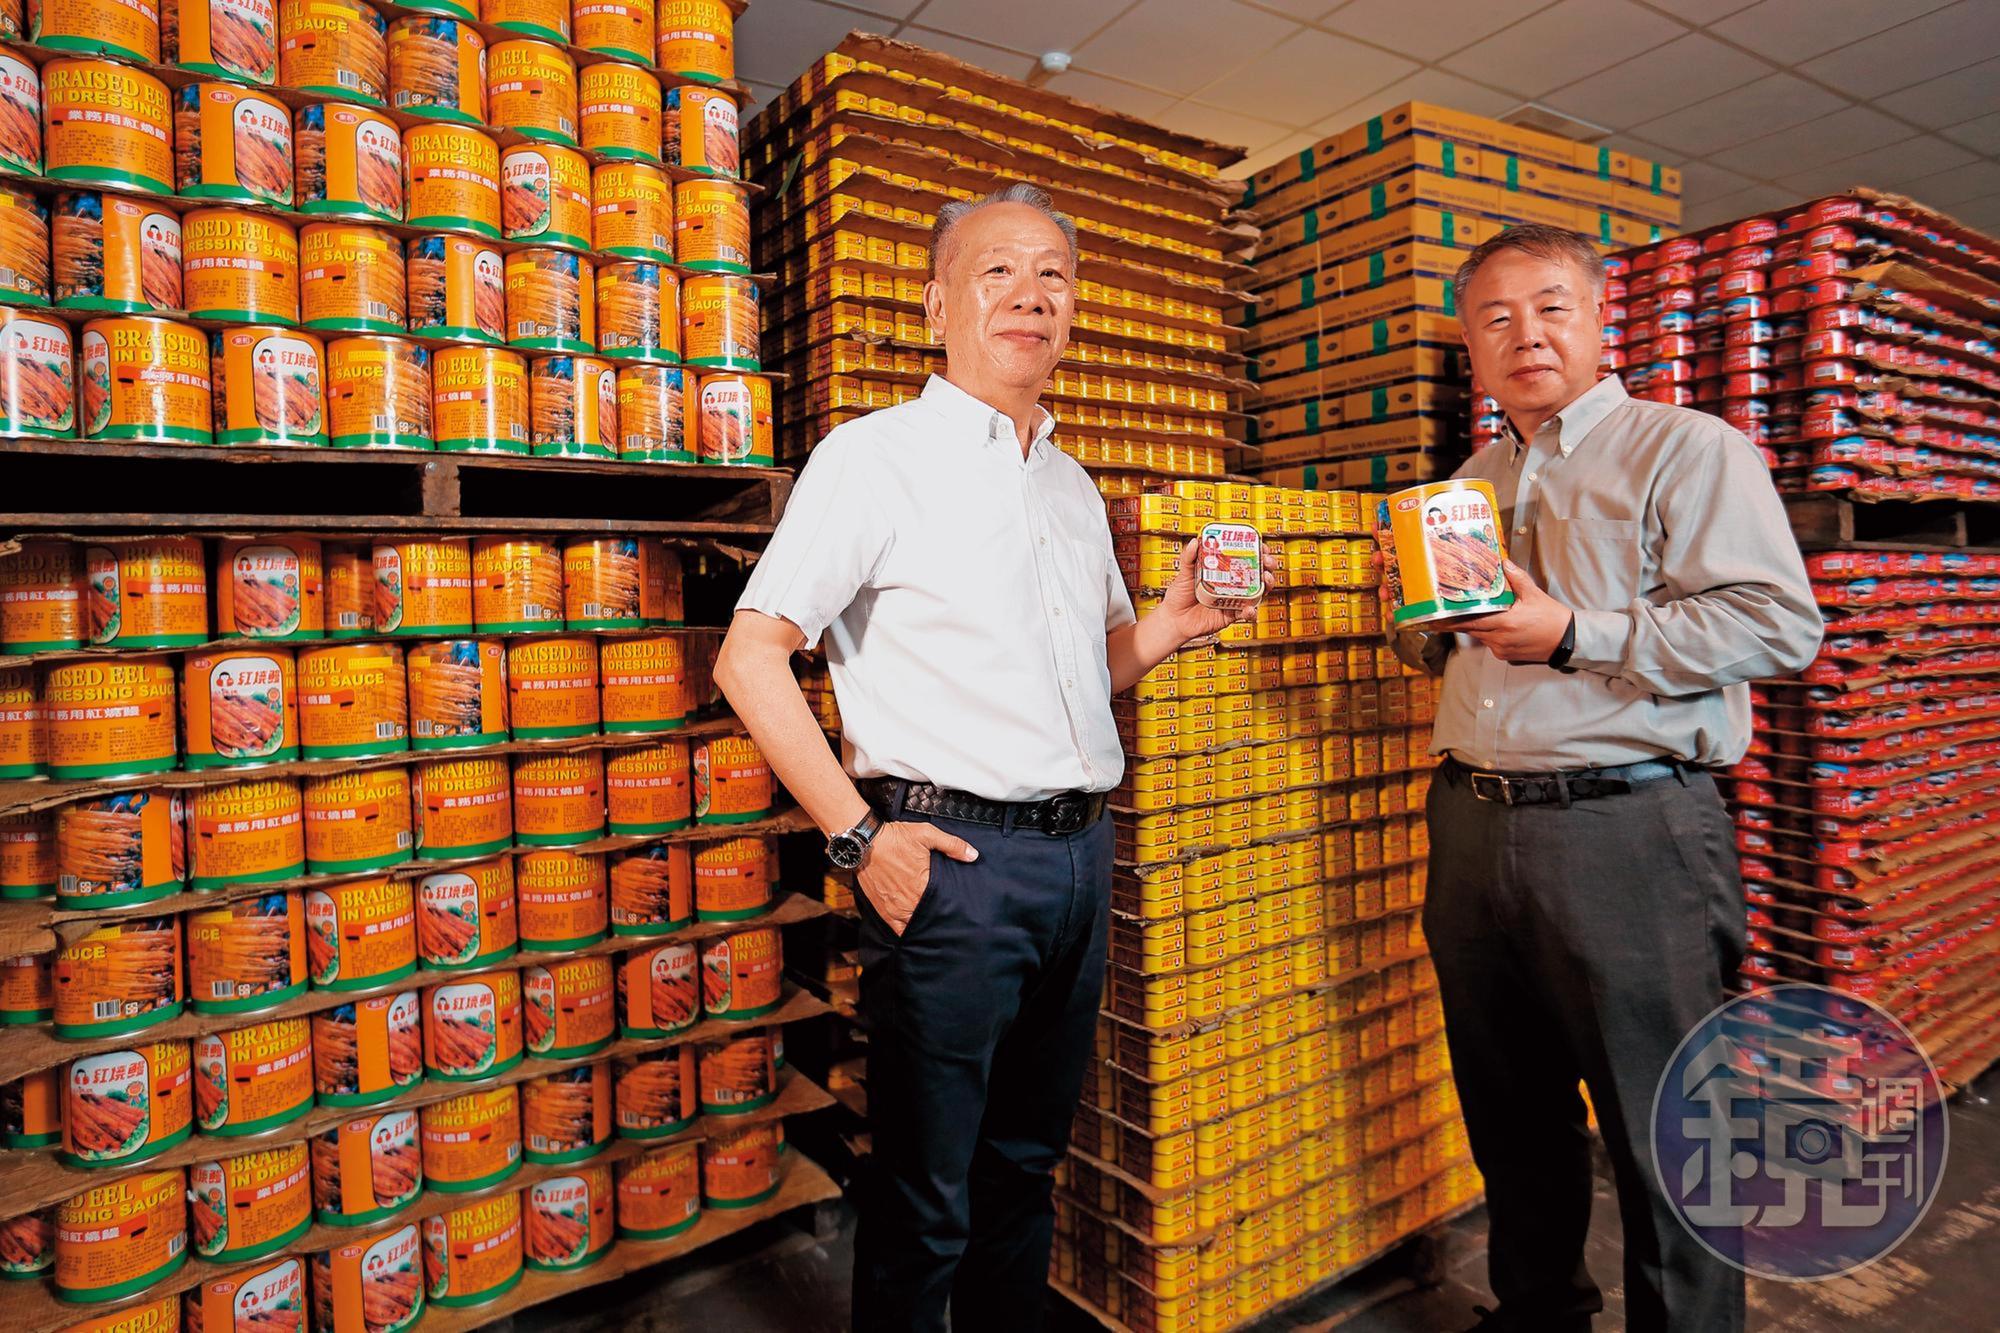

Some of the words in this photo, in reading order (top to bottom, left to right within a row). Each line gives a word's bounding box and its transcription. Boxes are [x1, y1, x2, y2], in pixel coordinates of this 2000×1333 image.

[695, 2, 721, 20] EEL
[294, 19, 348, 33] SAUCE
[502, 48, 532, 66] EEL
[522, 65, 567, 86] SAUCE
[613, 73, 643, 93] EEL
[49, 70, 140, 98] BRAISED
[68, 91, 162, 120] DRESSING
[67, 109, 166, 141] 業務用紅燒鰻
[412, 134, 481, 156] BRAISED
[412, 151, 425, 165] IN
[428, 152, 496, 176] DRESSING
[511, 161, 549, 178] 紅燒鰻
[553, 170, 568, 184] IN
[599, 172, 628, 189] EEL
[618, 187, 661, 203] SAUCE
[687, 204, 728, 215] SAUCE
[236, 221, 275, 243] EEL
[304, 231, 335, 250] EEL
[323, 250, 378, 265] SAUCE
[689, 299, 729, 312] SAUCE
[113, 328, 201, 356] BRAISED
[114, 348, 136, 363] IN
[336, 365, 385, 380] SAUCE
[451, 356, 483, 373] EEL
[471, 374, 519, 389] SAUCE
[1451, 503, 1491, 522] 紅燒鰻
[1221, 530, 1257, 542] 紅燒鰻
[124, 565, 144, 578] IN
[255, 557, 297, 572] 紅燒鰻
[406, 561, 422, 573] IN
[487, 560, 532, 573] SAUCE
[309, 656, 341, 675] EEL
[521, 661, 589, 675] DRESSING
[608, 658, 673, 672] DRESSING
[109, 666, 150, 685] EEL
[237, 669, 281, 686] 紅燒鰻
[331, 672, 385, 688] SAUCE
[713, 753, 726, 766] IN
[425, 759, 496, 780] BRAISED
[330, 772, 367, 789] EEL
[425, 780, 439, 792] IN
[354, 784, 402, 801] SAUCE
[199, 804, 213, 817] IN
[217, 794, 297, 816] DRESSING
[522, 875, 588, 888] DRESSING
[435, 884, 475, 899] 紅燒鰻
[483, 887, 498, 900] IN
[342, 908, 360, 922] IN
[734, 951, 748, 961] IN
[559, 983, 576, 994] IN
[452, 993, 492, 1011] 紅燒鰻
[499, 993, 512, 1007] IN
[231, 1049, 251, 1062] IN
[92, 1060, 145, 1085] 紅燒鰻
[154, 1062, 171, 1077] IN
[470, 1098, 512, 1124] SAUCE
[231, 1174, 251, 1189] IN
[90, 1183, 135, 1207] EEL
[119, 1182, 177, 1217] SAUCE
[549, 1183, 587, 1203] 紅燒鰻
[452, 1228, 468, 1240] IN
